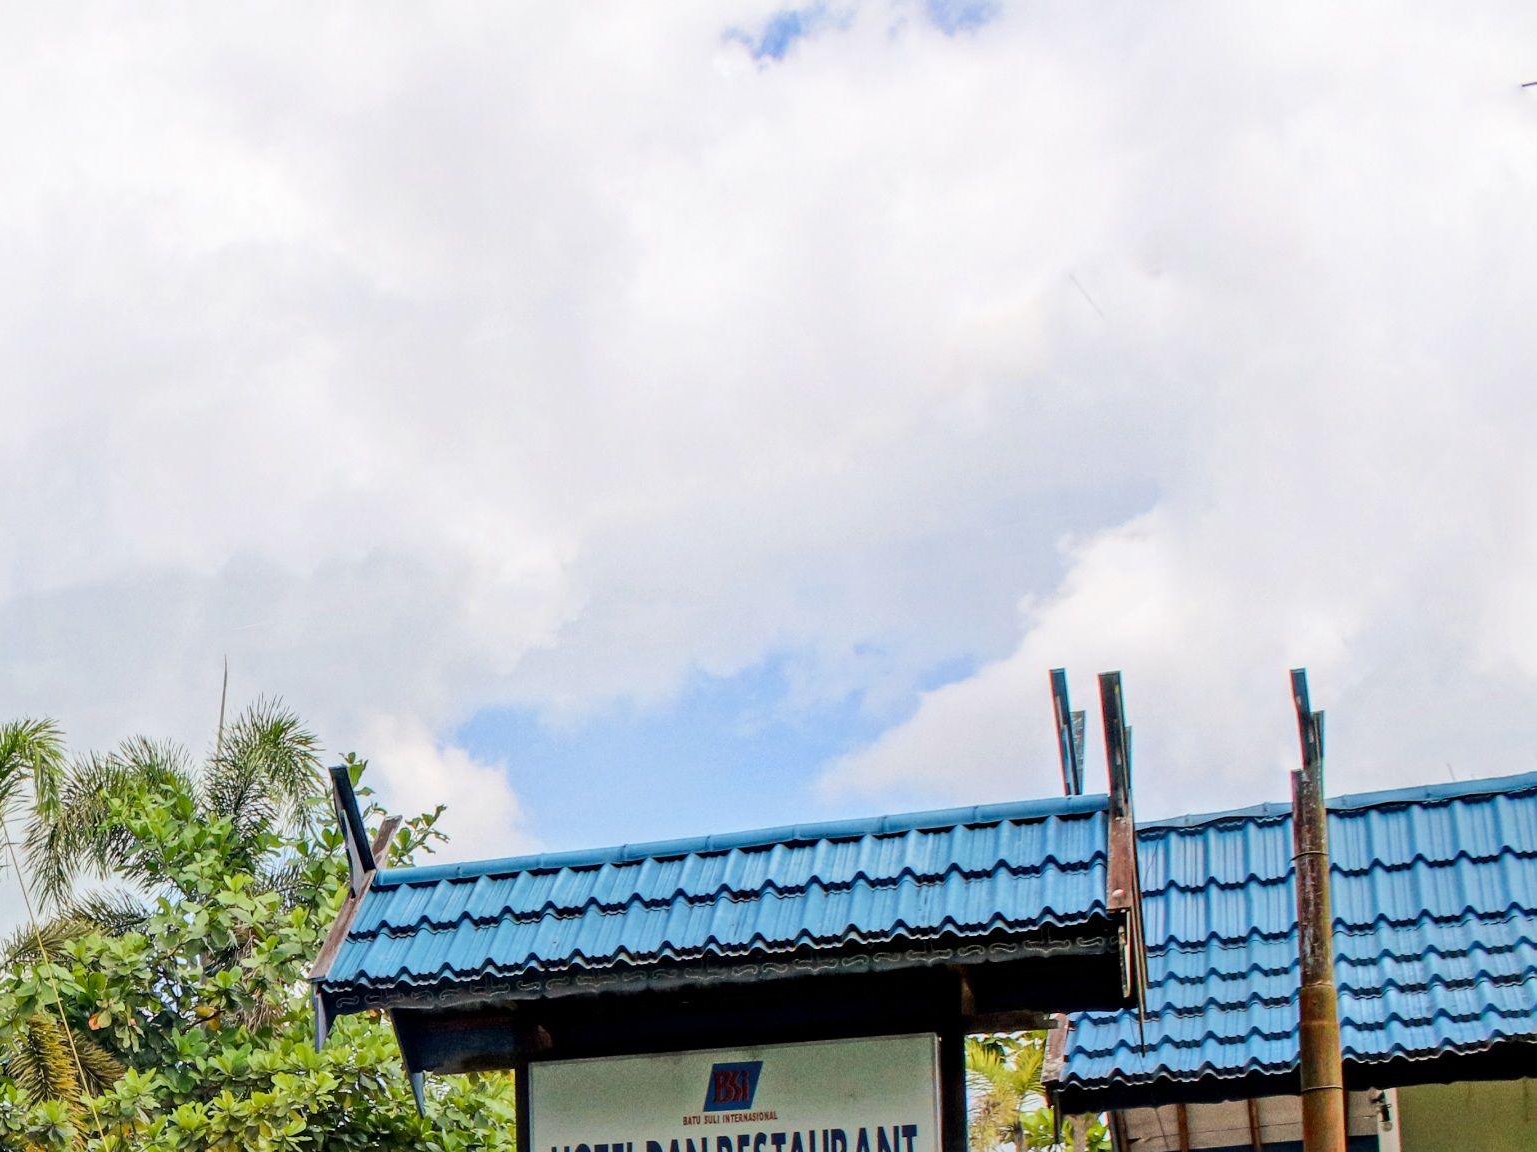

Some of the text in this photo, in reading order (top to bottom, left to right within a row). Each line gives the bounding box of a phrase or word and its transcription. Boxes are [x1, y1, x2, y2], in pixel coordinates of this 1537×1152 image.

[683, 1111, 778, 1126] BATU SULI INTERNASIONAL
